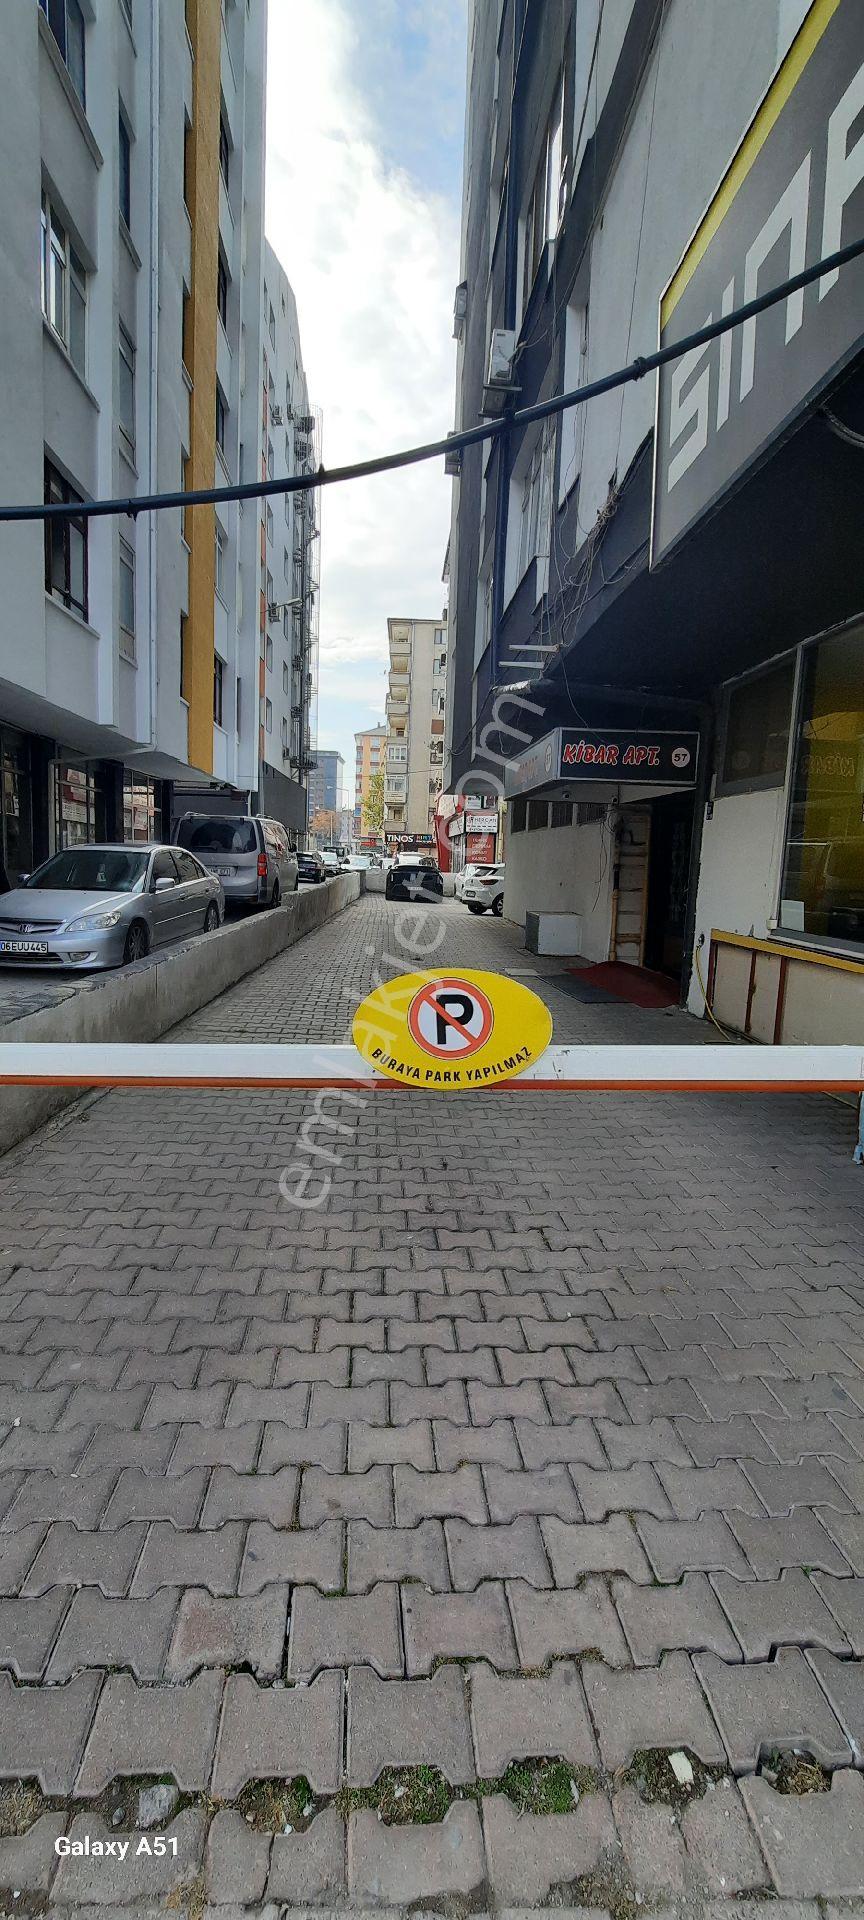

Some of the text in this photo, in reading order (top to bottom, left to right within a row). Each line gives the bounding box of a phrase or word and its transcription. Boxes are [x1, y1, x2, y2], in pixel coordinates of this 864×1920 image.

[562, 740, 619, 765] KİBAR
[622, 745, 660, 766] APT.
[673, 753, 688, 762] 57
[371, 1046, 533, 1082] BURAYA PARK YAPILMAZ
